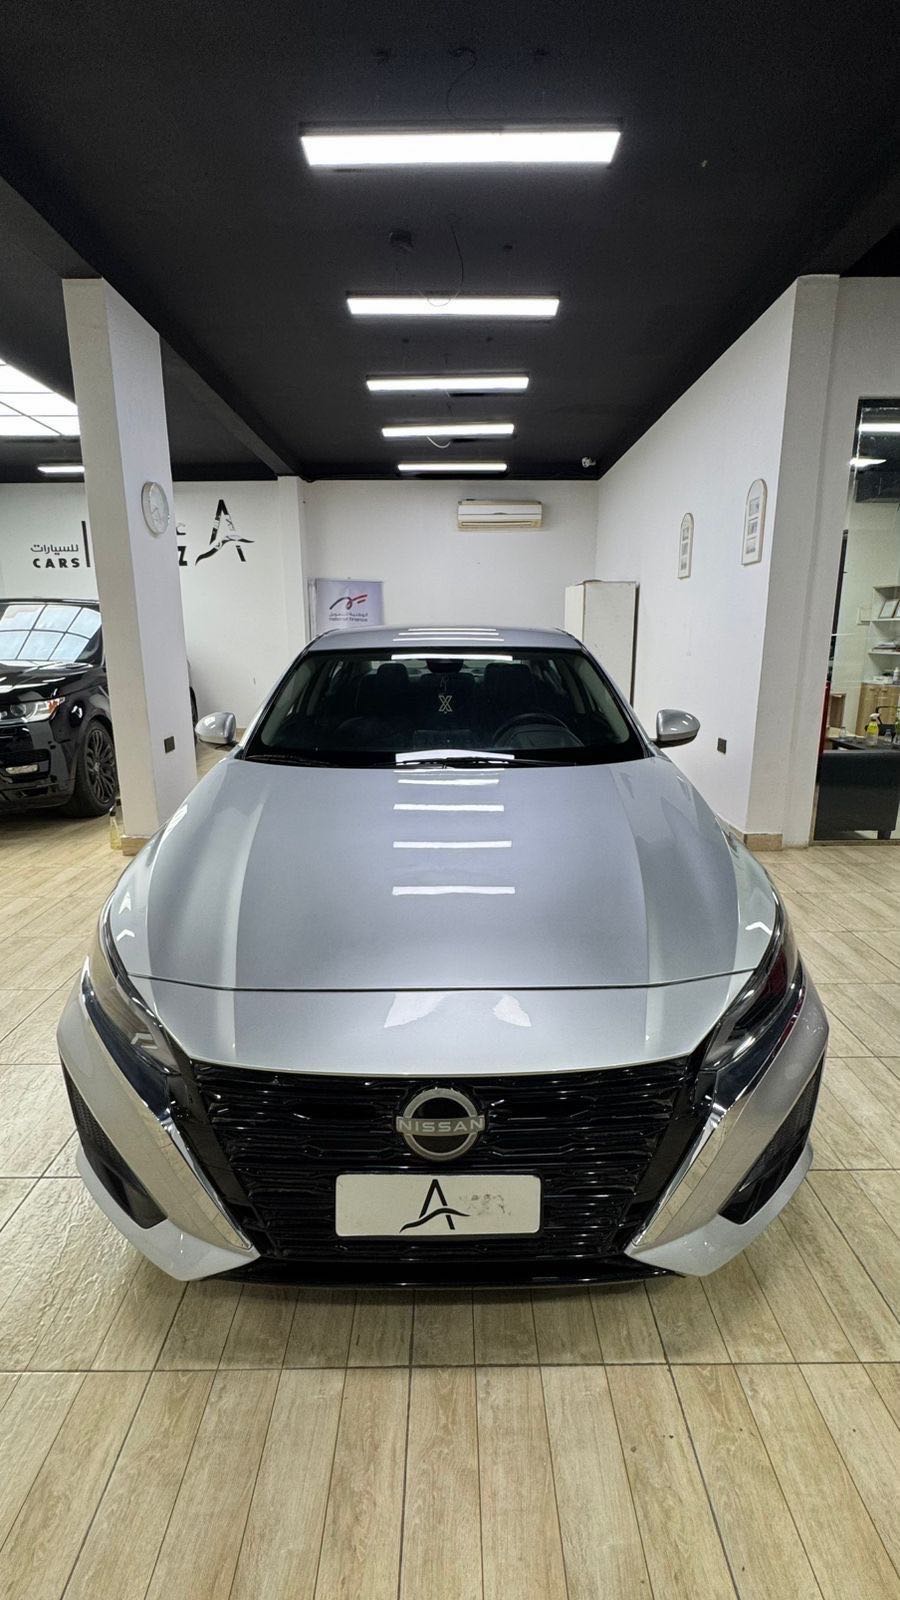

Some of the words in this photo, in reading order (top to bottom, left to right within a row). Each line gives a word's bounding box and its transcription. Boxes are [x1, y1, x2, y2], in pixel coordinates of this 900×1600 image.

[30, 544, 79, 556] للسيارات
[32, 558, 80, 569] CARS
[399, 1119, 483, 1133] NISSAN
